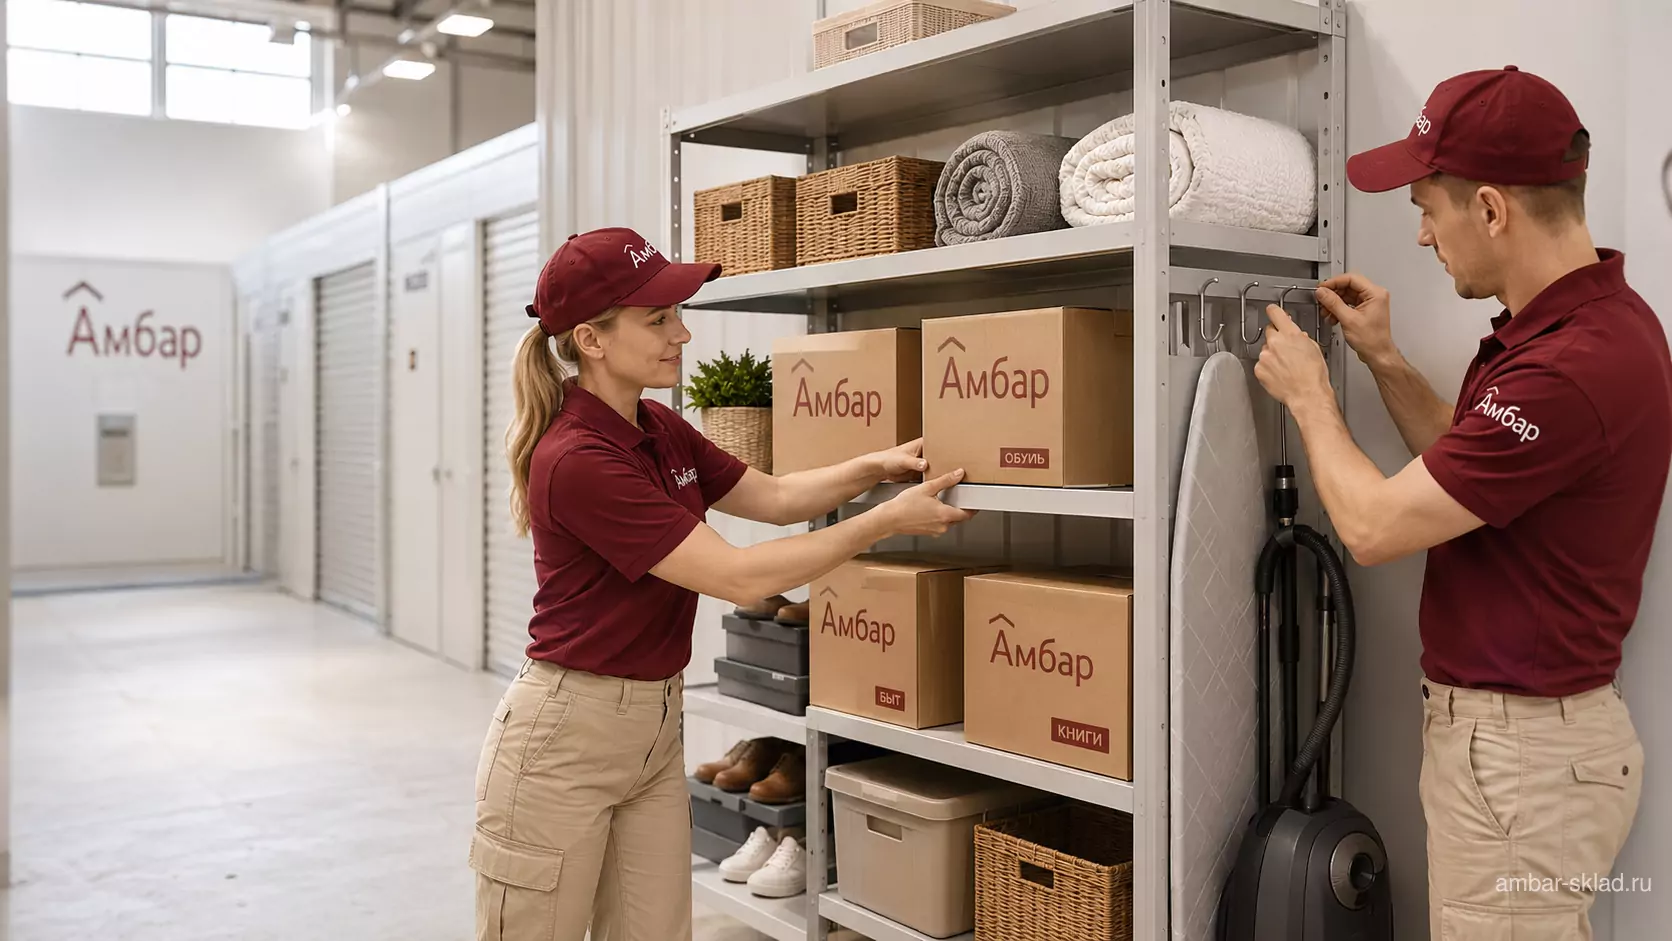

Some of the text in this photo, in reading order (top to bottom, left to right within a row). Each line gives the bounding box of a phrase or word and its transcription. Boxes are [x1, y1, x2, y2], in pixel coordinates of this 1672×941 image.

[629, 240, 657, 268] Амб
[66, 305, 202, 370] Амбар
[792, 377, 882, 427] Амбар
[938, 355, 1050, 408] Амбар
[1474, 392, 1540, 442] Амбар
[820, 601, 895, 652] Амбар
[989, 629, 1094, 687] Амбар
[880, 691, 901, 706] БЫТ
[1057, 724, 1102, 747] КНИГИ
